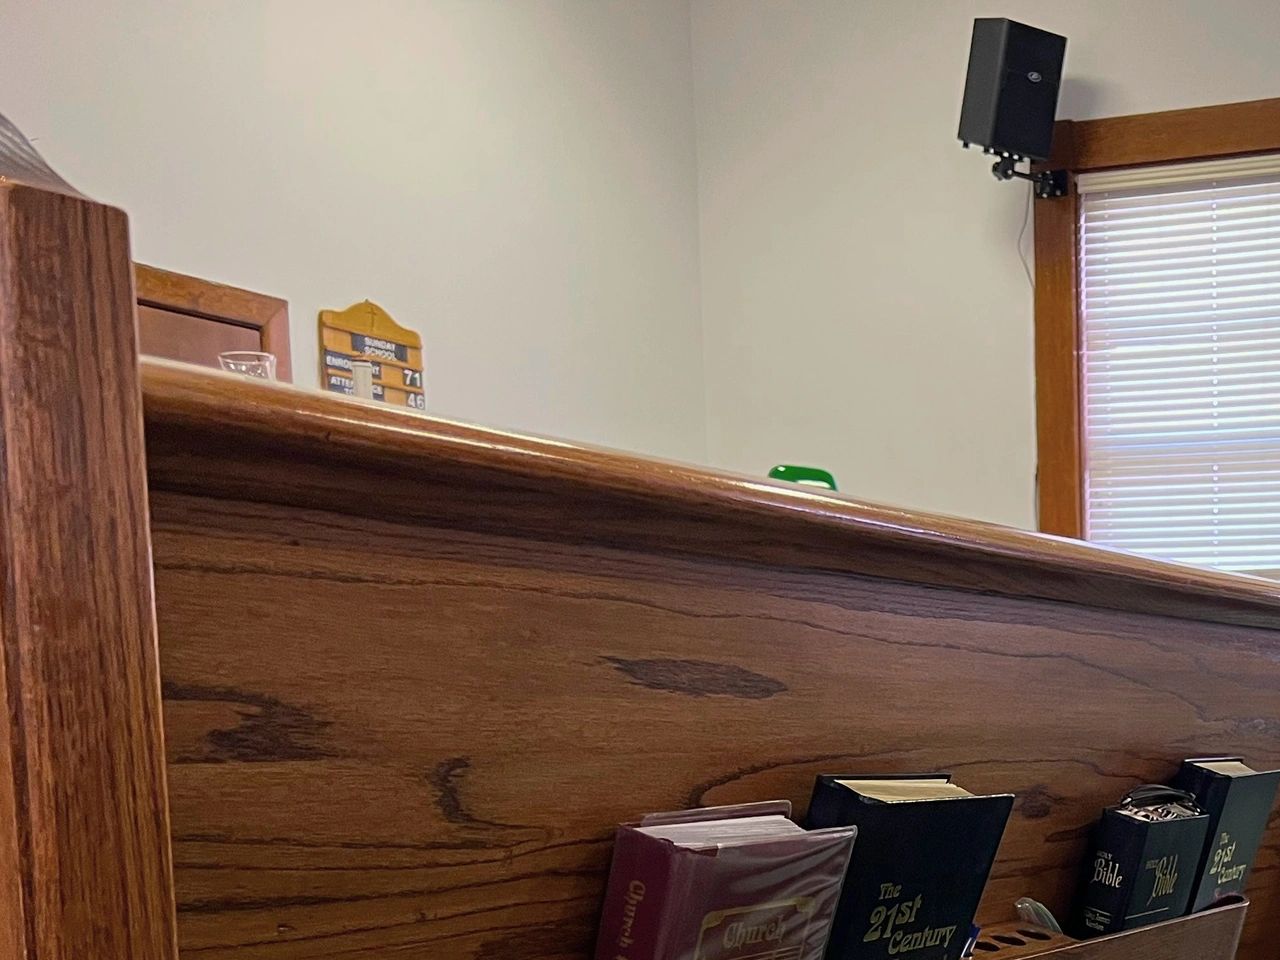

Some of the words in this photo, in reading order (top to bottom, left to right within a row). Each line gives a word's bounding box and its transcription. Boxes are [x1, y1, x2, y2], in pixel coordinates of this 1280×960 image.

[364, 337, 396, 351] SUNDAY
[364, 346, 397, 361] SCHOOL
[403, 369, 421, 387] 71
[407, 392, 425, 410] 46
[1089, 858, 1123, 888] Bible
[1209, 841, 1237, 875] 21st
[879, 882, 902, 900] The
[1146, 854, 1178, 906] Bible
[619, 879, 646, 948] Church
[863, 893, 922, 942] 21st
[722, 914, 786, 950] Church
[888, 925, 957, 955] Century
